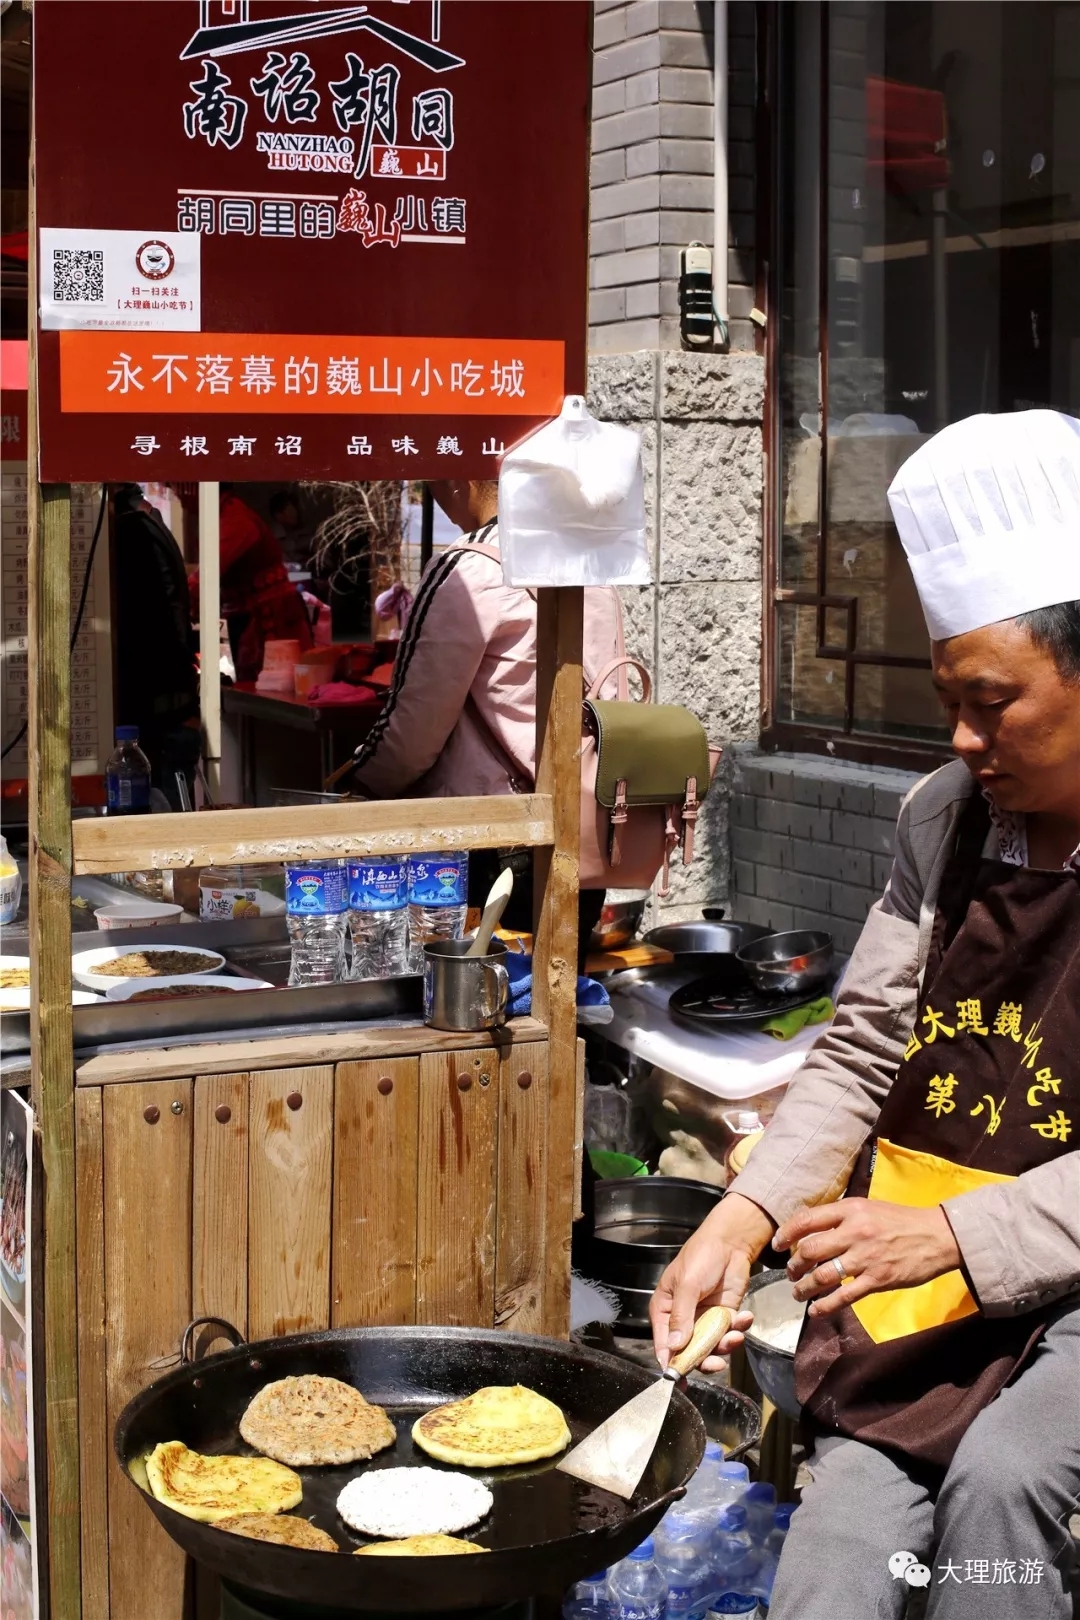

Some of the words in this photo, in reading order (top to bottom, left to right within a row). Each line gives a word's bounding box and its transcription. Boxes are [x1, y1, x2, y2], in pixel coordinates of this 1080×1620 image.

[183, 52, 454, 179] 南诏胡同
[258, 132, 354, 154] NANZHAO
[269, 153, 353, 173] HUTONG
[378, 149, 438, 175] 巍山
[177, 188, 466, 248] 胡同里的巍山小镇
[132, 287, 179, 296] 扫一扫关注
[107, 352, 526, 398] 永不落幕的巍山小吃城
[130, 435, 303, 456] 寻根南诏
[347, 435, 505, 456] 品味巍山
